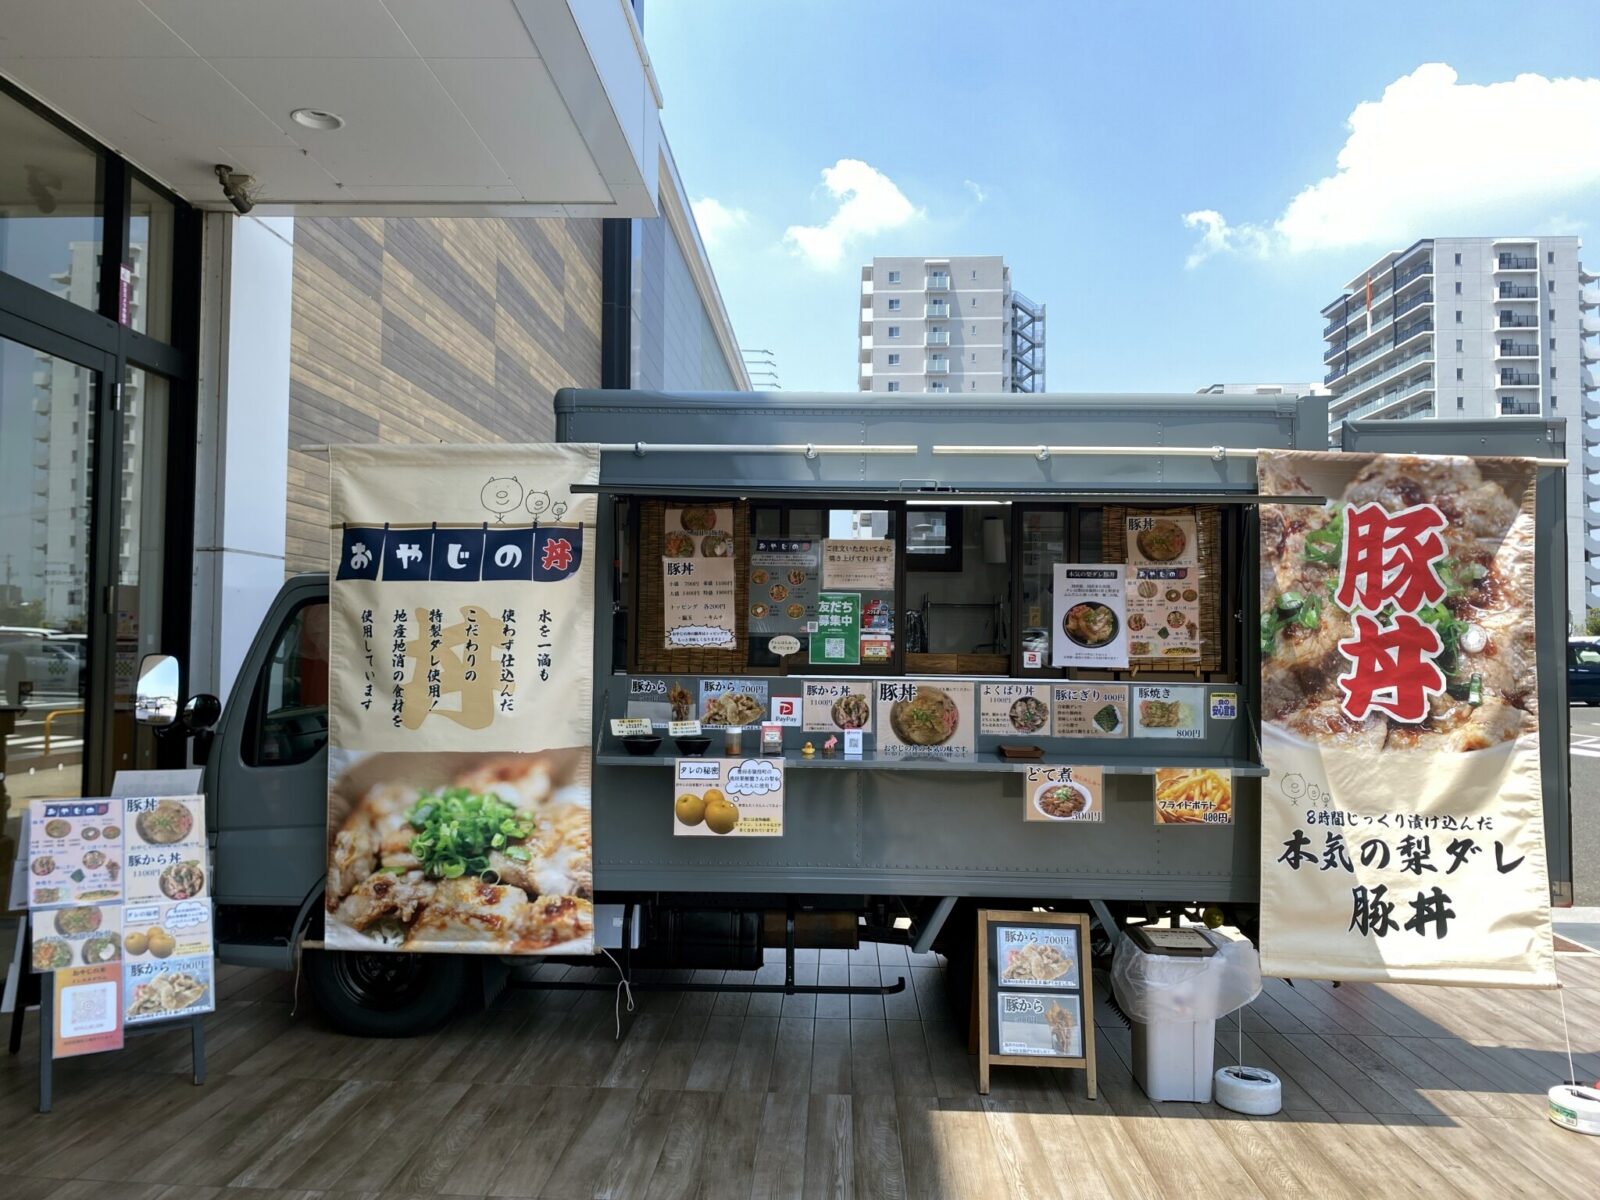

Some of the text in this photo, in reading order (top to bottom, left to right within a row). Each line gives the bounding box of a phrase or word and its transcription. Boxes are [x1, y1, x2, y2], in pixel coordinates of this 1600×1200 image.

[1128, 517, 1154, 530] 豚丼
[350, 538, 573, 570] おやじの丼
[667, 562, 694, 575] 豚丼
[818, 601, 853, 613] 友だち
[1334, 502, 1449, 722] 豚丼
[818, 615, 853, 627] 募集中
[464, 609, 479, 682] こだわりの
[536, 609, 552, 682] 水を一滴も
[360, 609, 375, 711] 使用しています
[499, 609, 516, 712] 使わず仕込んだ
[391, 609, 407, 728] 地産地消の食材を
[631, 679, 667, 693] 豚から
[704, 681, 764, 693] 豚から 700円
[806, 685, 850, 696] 豚から丼
[880, 683, 916, 701] 豚丼
[984, 685, 1035, 695] よくばり丼
[1139, 688, 1171, 698] 豚焼き
[1055, 689, 1100, 701] 豚にぎり
[1176, 730, 1200, 738] 800円
[680, 766, 719, 774] タレの秘密
[1028, 767, 1072, 782] どて煮
[127, 798, 156, 812] 豚丼
[1159, 801, 1216, 809] フライドポテト
[1203, 813, 1228, 822] 400円
[1306, 809, 1494, 831] 8時間じっくり漬け込んだ
[1277, 829, 1526, 875] 本気の梨ダレ
[128, 852, 181, 867] 豚から丼
[134, 869, 160, 877] 1100円
[1349, 884, 1456, 940] 豚丼
[1005, 930, 1069, 945] 豚から 700円
[131, 960, 205, 977] 豚から 700円
[1005, 997, 1044, 1013] 豚から
